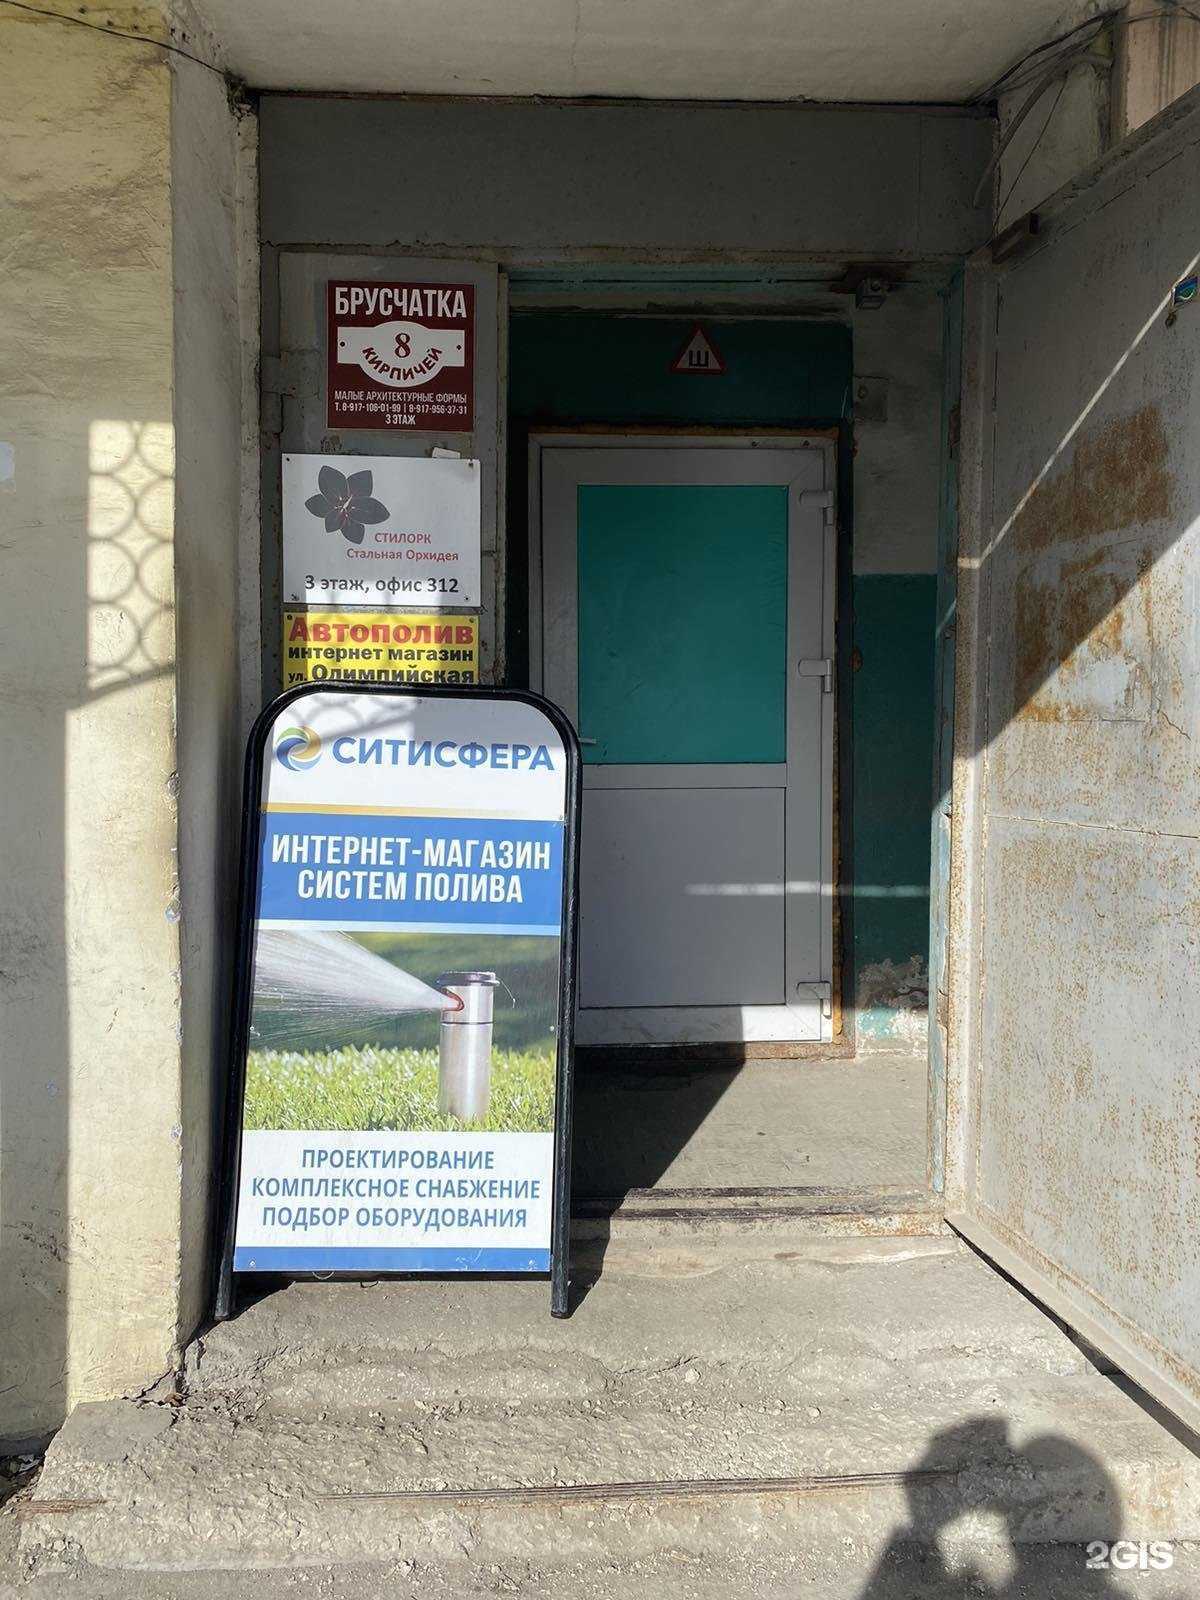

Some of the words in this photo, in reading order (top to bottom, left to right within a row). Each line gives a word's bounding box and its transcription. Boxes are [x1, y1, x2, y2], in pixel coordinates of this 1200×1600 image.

[335, 286, 467, 318] БРУСЧАТКА
[394, 332, 411, 358] 8
[362, 346, 443, 381] КИРПИЧЕЙ
[688, 350, 709, 367] Ш
[334, 391, 364, 401] МАЛЫЕ
[366, 391, 434, 403] АРХИТЕКТУРНЫЕ
[436, 393, 467, 404] ФОРМЫ
[385, 414, 391, 424] 3
[393, 414, 416, 425] ЭТАЖ
[374, 532, 432, 545] СТИЛОРК
[346, 548, 403, 560] Стальная
[405, 549, 459, 562] Орхидея
[305, 574, 315, 590] 3
[320, 577, 370, 594] этаж,
[375, 577, 422, 595] офис
[427, 577, 460, 593] 312
[289, 616, 474, 645] Автополив
[288, 646, 383, 663] интернет
[388, 647, 473, 661] магазин
[288, 671, 307, 684] ул.
[312, 664, 474, 683] Олимпийская
[332, 736, 554, 771] СИТИСФЕРА
[271, 834, 551, 869] ИНТЕРНЕТ-МАГАЗИН
[297, 869, 406, 900] СИСТЕМ
[415, 872, 523, 903] ПОЛИВА
[302, 1149, 495, 1170] ПРОЕКТИРОВАНИЕ
[252, 1177, 409, 1197] КОМПЛЕКСНОЕ
[416, 1179, 540, 1199] СНАБЖЕНИЕ
[262, 1207, 349, 1231] ПОДБОР
[356, 1208, 526, 1232] ОБОРУДОВАНИЯ
